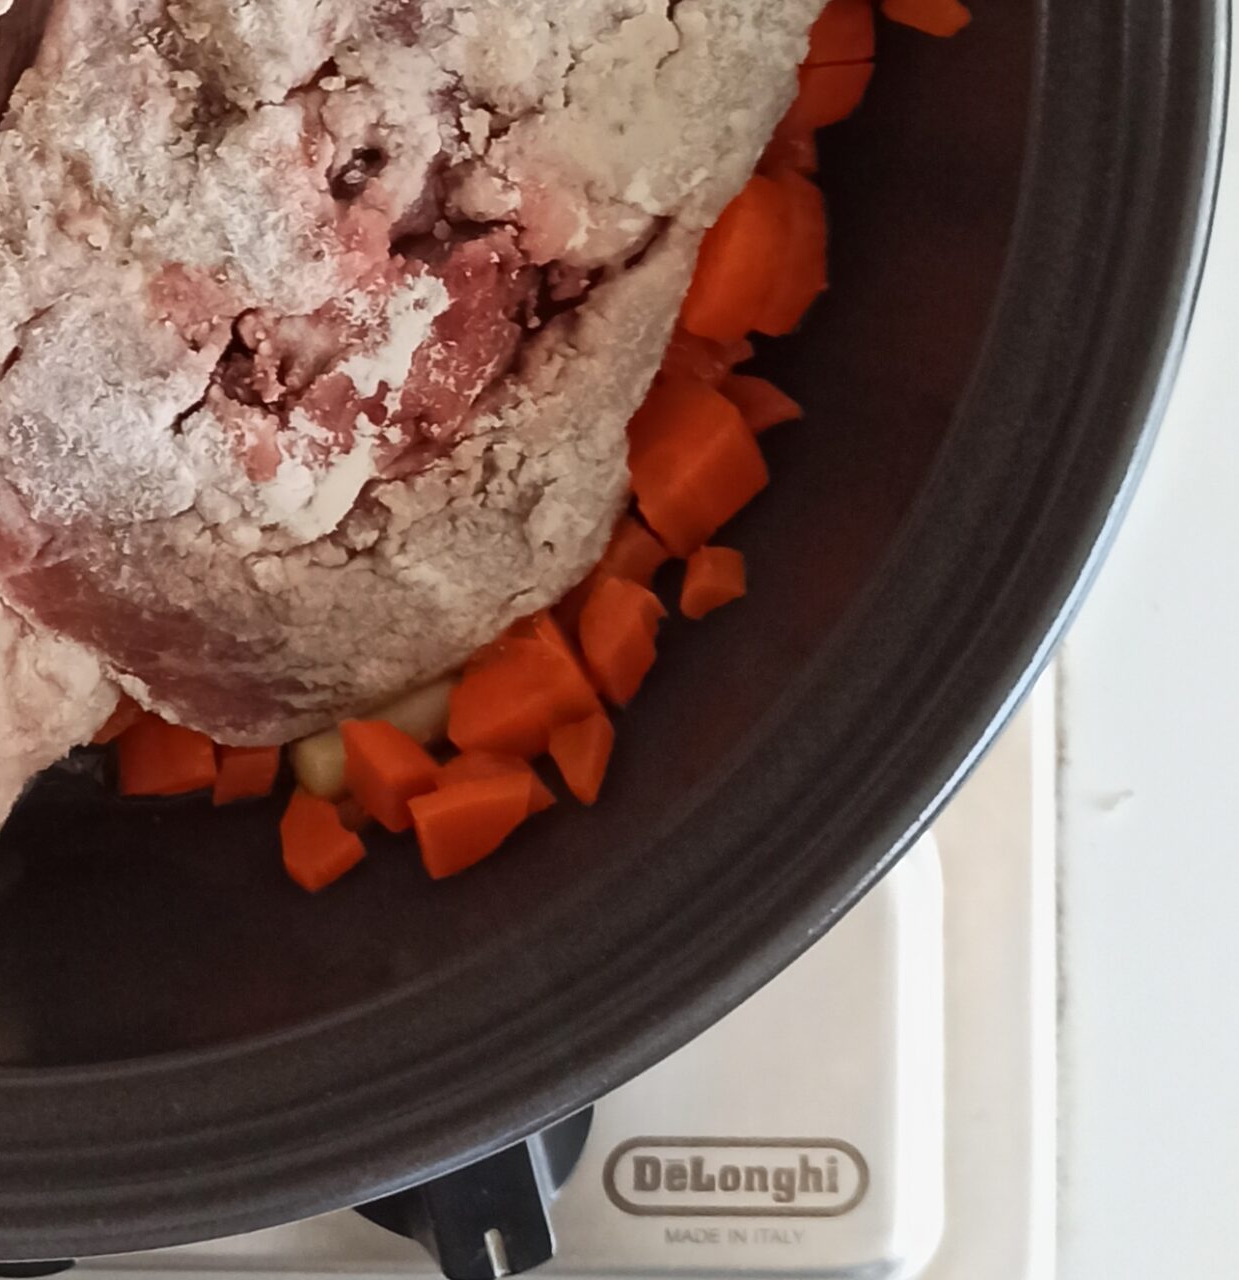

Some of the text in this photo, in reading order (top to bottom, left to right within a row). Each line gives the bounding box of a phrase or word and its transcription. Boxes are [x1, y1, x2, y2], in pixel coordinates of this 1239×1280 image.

[665, 1227, 805, 1245] MADE IN ITALY
